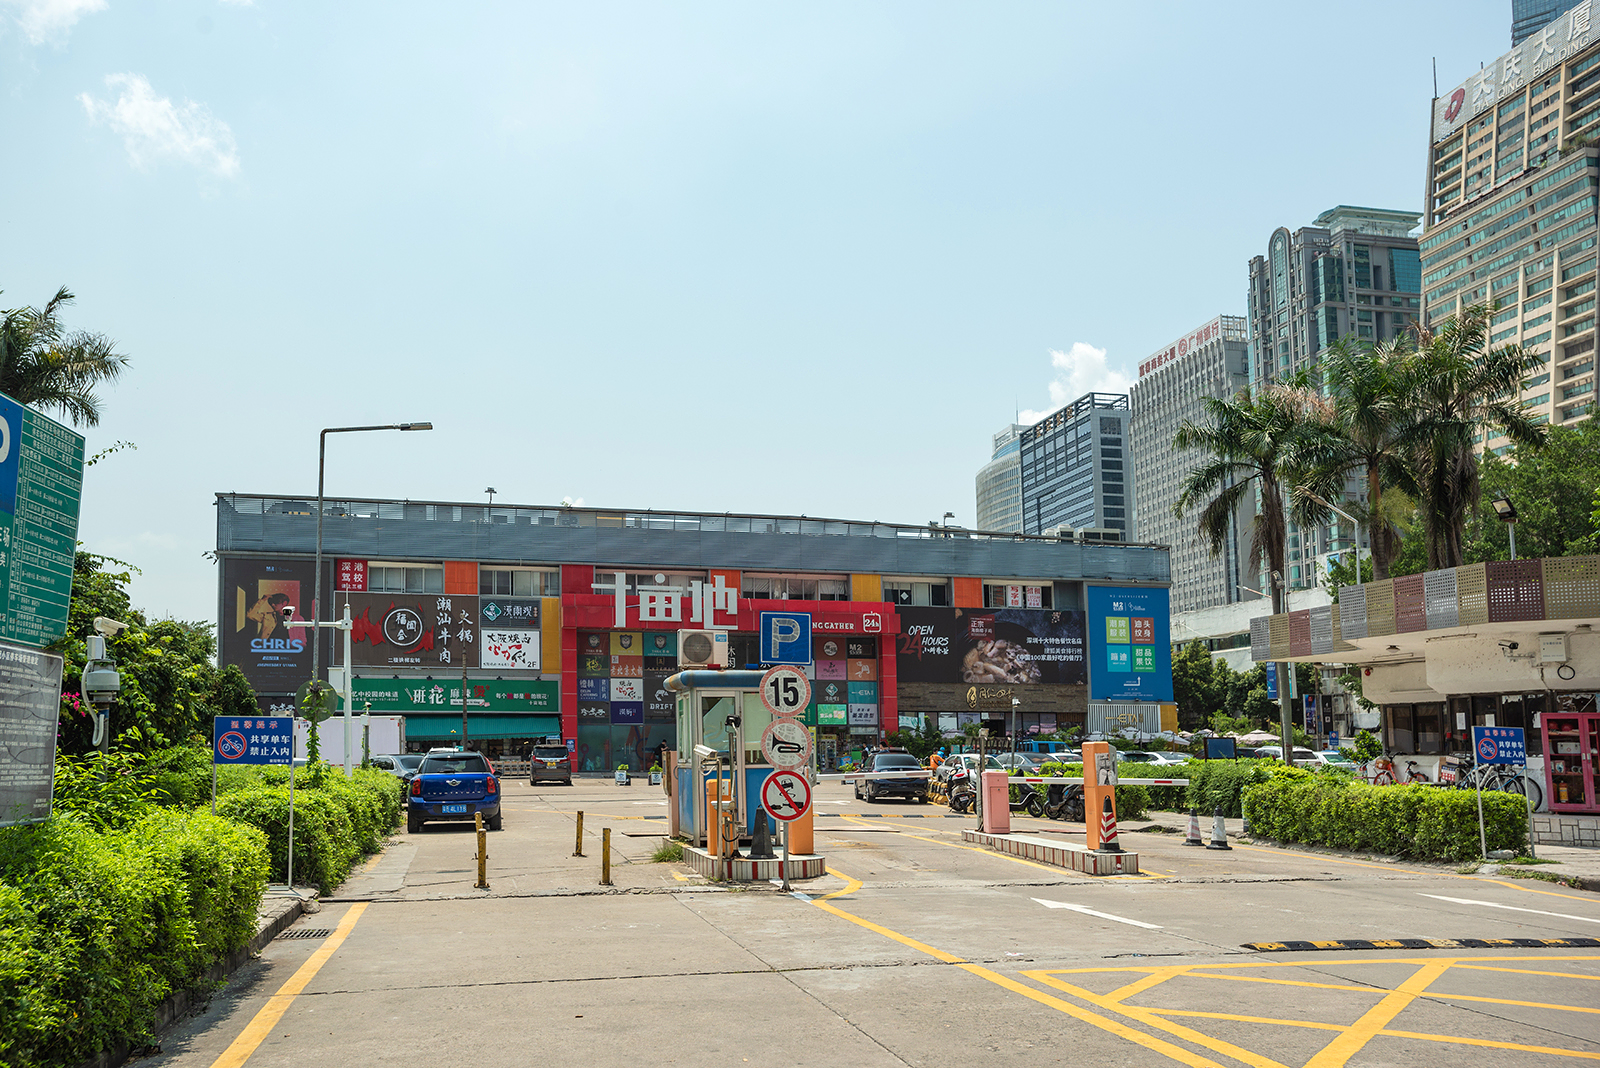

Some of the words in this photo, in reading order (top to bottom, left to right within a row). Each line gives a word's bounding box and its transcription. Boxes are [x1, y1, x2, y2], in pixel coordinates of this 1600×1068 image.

[1473, 1, 1592, 105] 大庆大厦
[1497, 76, 1525, 100] QING
[1533, 34, 1590, 78] BUILDING
[1187, 321, 1219, 351] 广州银行
[341, 562, 364, 572] 深港
[341, 573, 364, 583] 驾校
[436, 597, 453, 664] 潮汕牛肉
[456, 609, 474, 643] 火锅
[824, 622, 856, 632] GATHER
[908, 625, 935, 636] OPEN
[772, 617, 800, 659] P
[1134, 629, 1151, 637] 纹身
[250, 638, 304, 653] CHRIS
[897, 632, 926, 662] 24
[921, 637, 950, 647] HOURS
[1135, 648, 1152, 657] 甜品
[1135, 657, 1153, 666] 果饮
[412, 688, 444, 704] 班花
[770, 677, 799, 707] 15
[231, 720, 278, 729] 温馨提示
[250, 735, 290, 744] 共享单车
[1498, 741, 1524, 749] 共享单车
[250, 747, 290, 756] 禁止入内
[1499, 750, 1525, 759] 禁止入内
